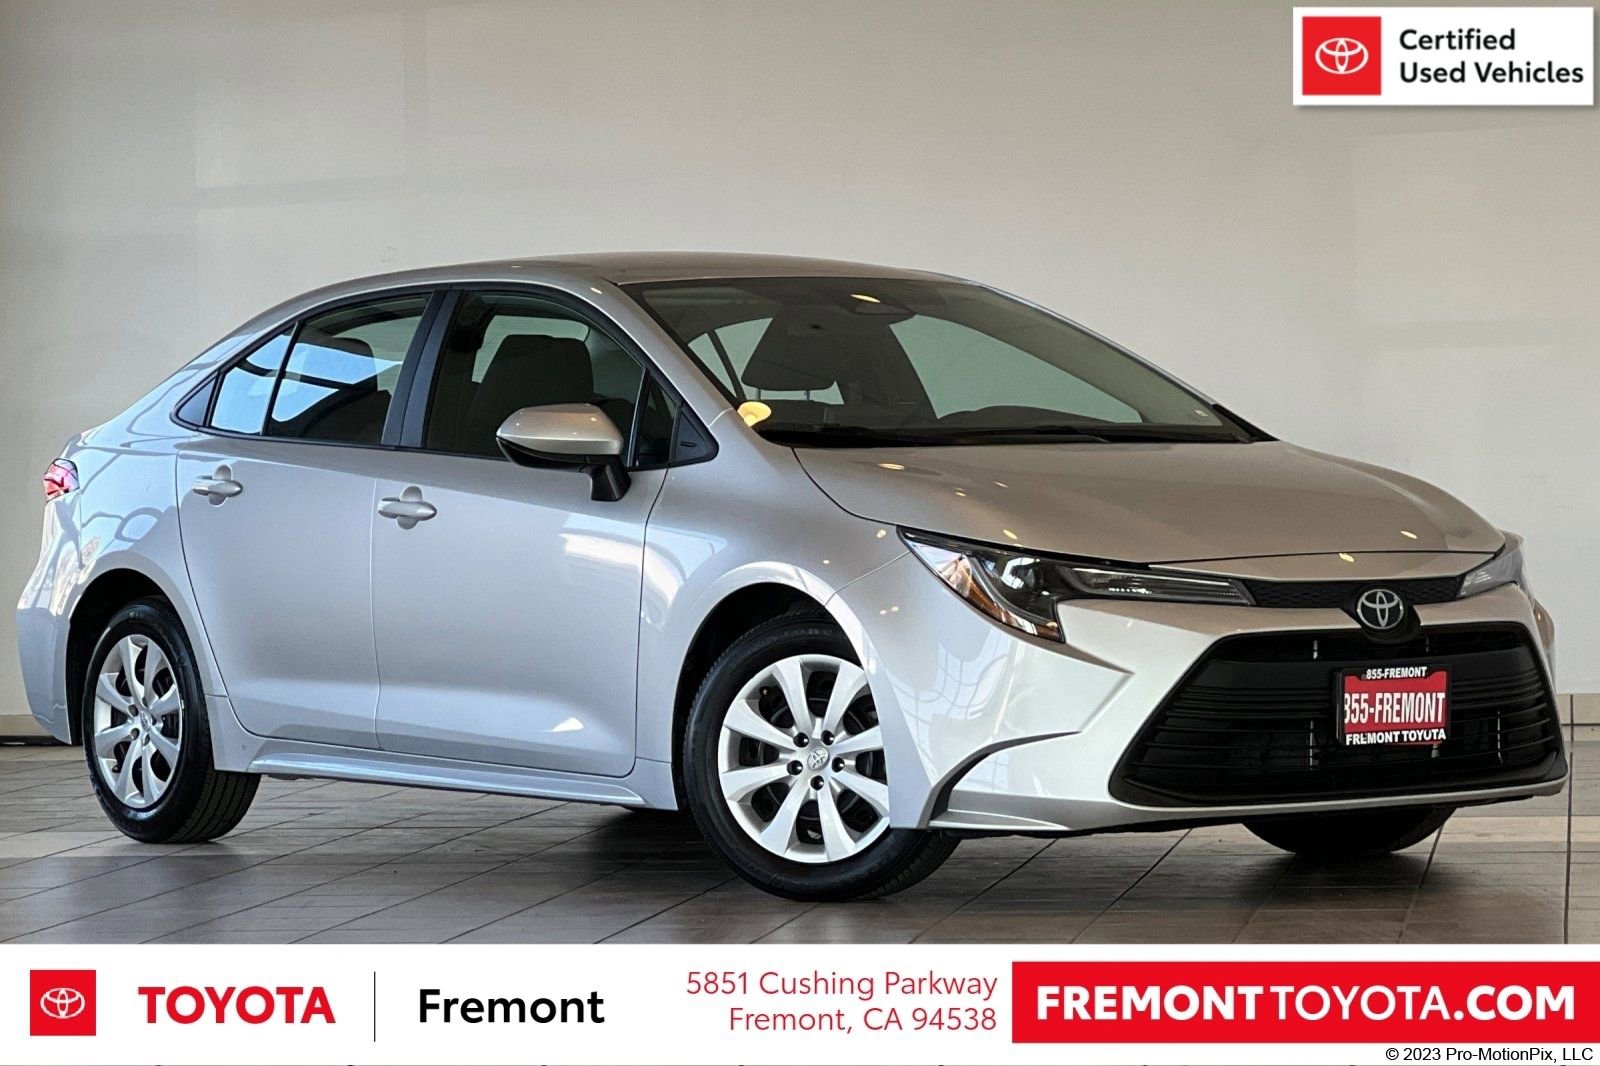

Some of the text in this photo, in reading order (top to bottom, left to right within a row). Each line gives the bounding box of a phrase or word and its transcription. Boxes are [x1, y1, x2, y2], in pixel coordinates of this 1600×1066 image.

[1366, 666, 1427, 680] 855-FREMONT
[1345, 728, 1447, 746] FREMONT TOYOTA
